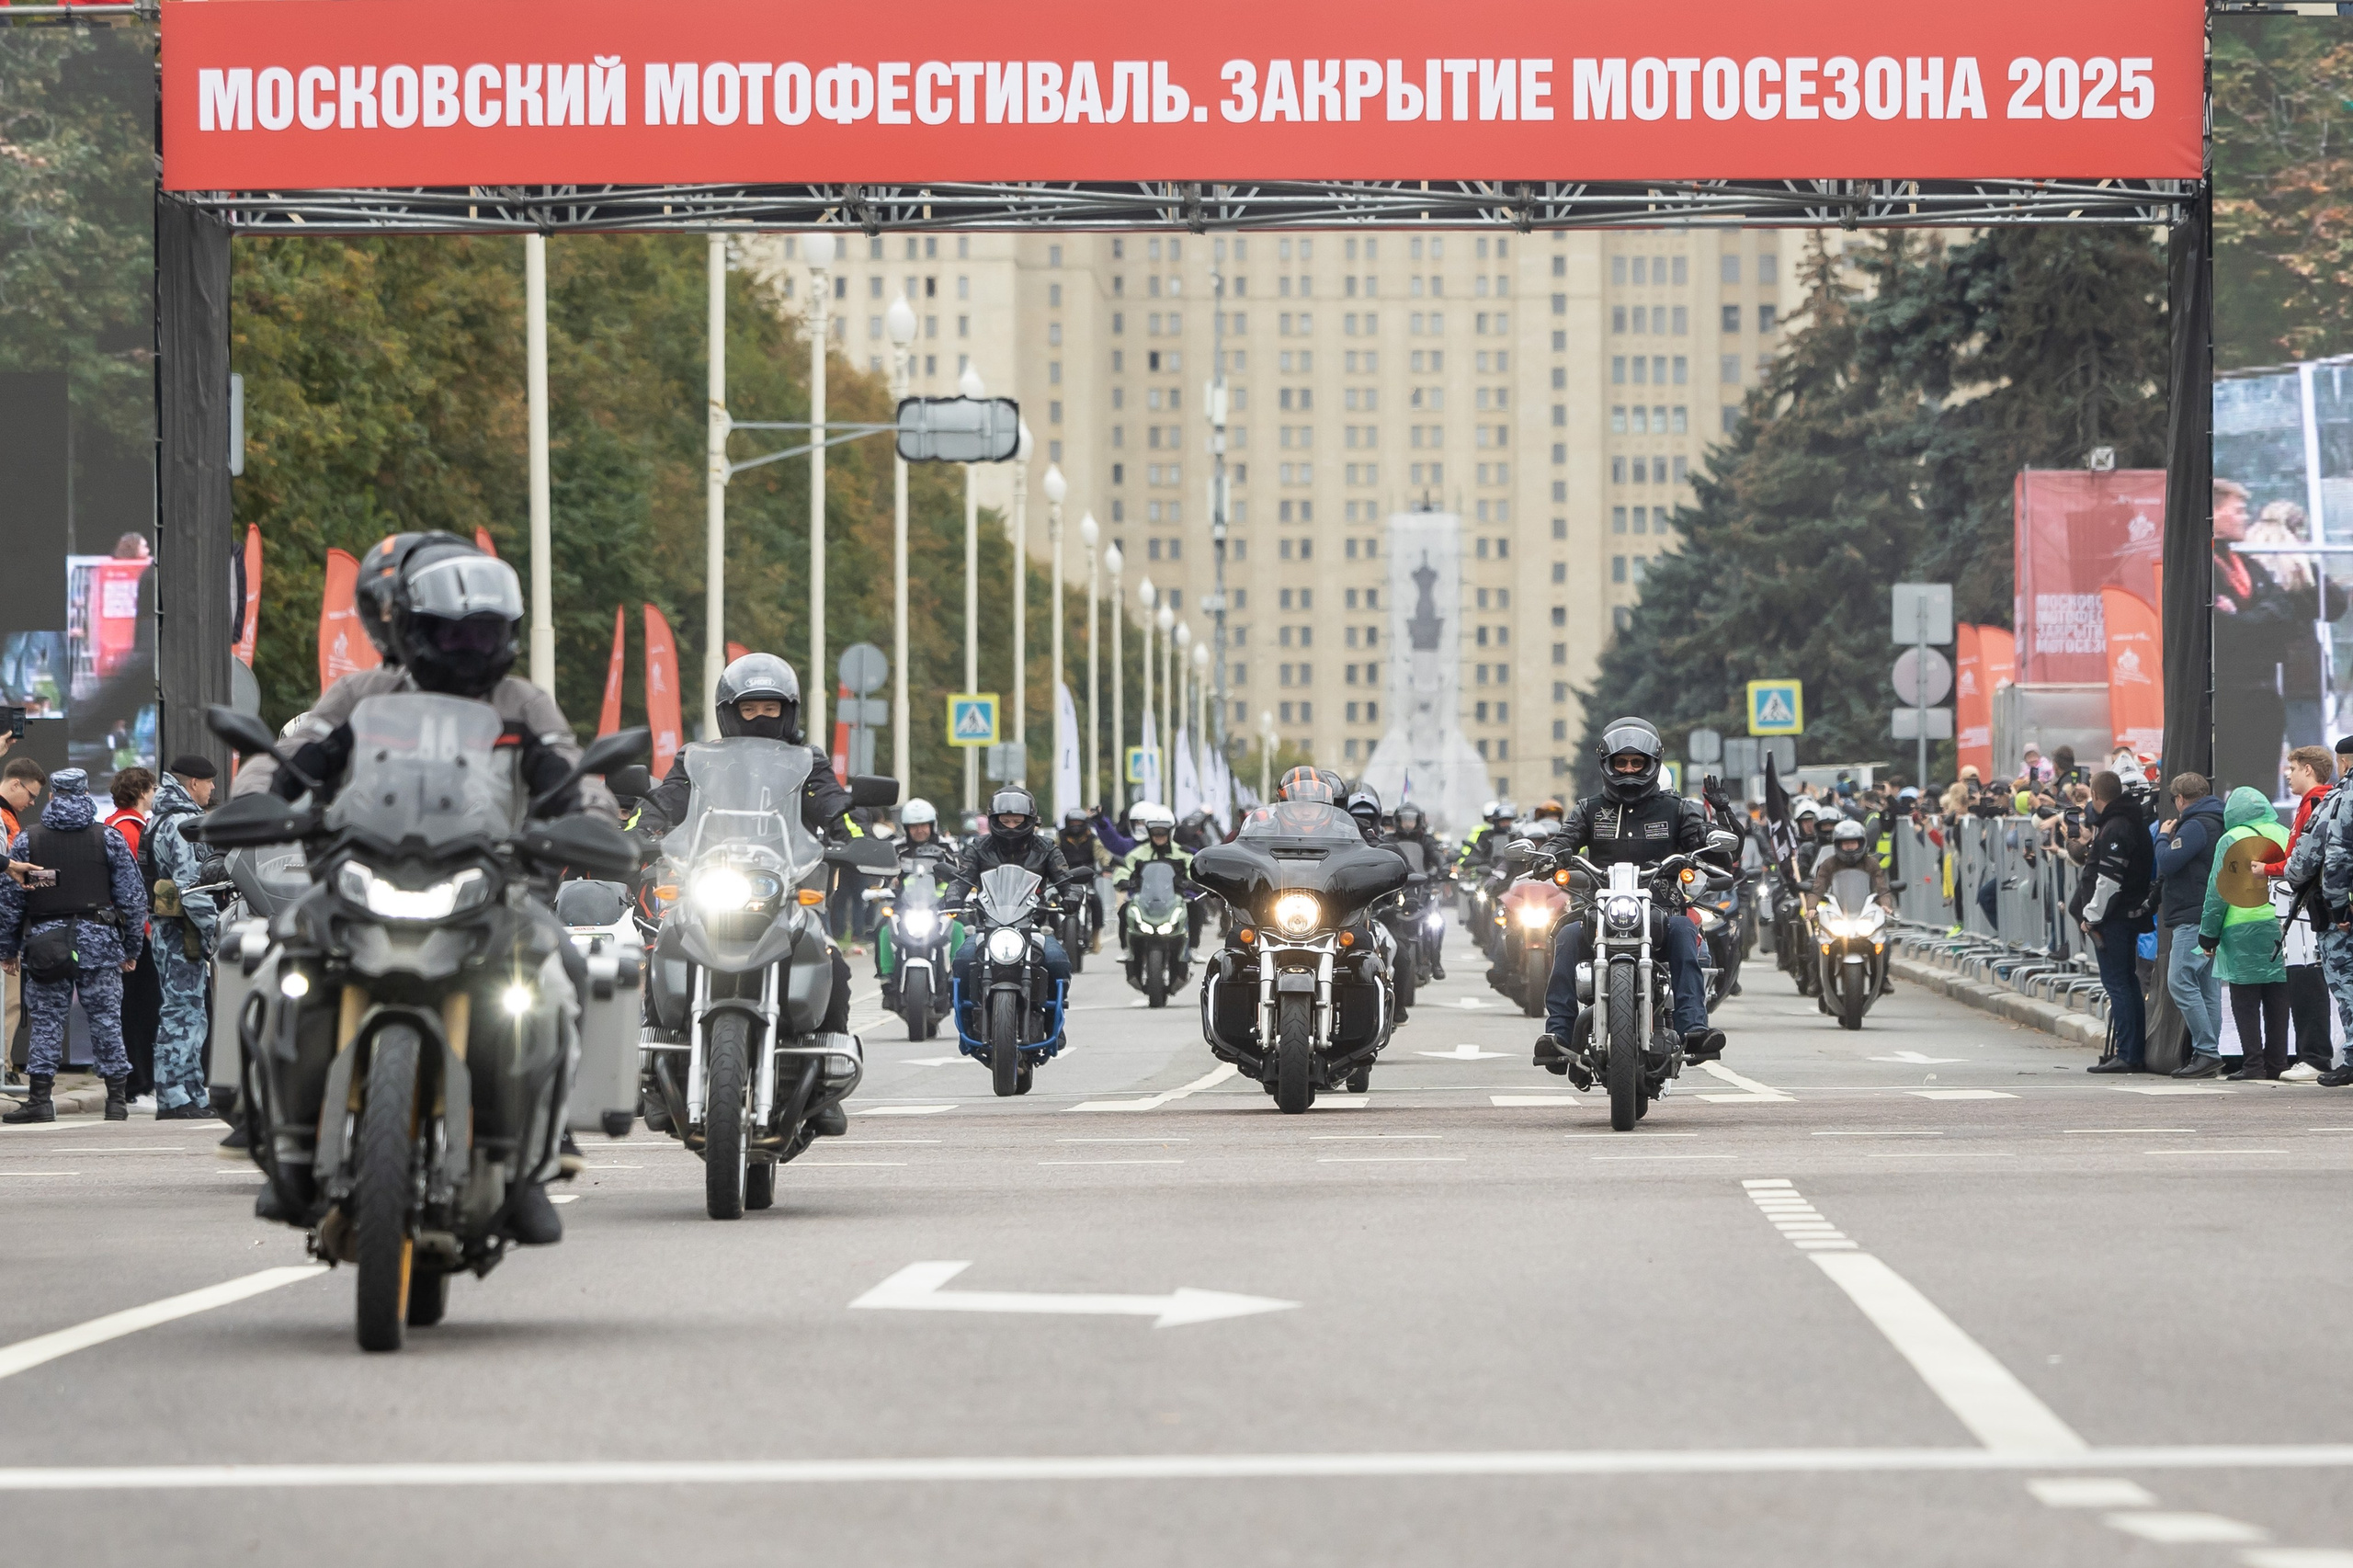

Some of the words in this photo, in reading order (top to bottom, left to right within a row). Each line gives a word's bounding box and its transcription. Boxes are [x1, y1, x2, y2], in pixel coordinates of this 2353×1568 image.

[199, 55, 626, 131] МОСКОВСКИЙ
[644, 60, 1208, 126] МОТОФЕСТИВАЛЬ.
[1220, 59, 1554, 122] ЗАКРЫТИЕ
[1573, 56, 1988, 120] МОТОСЕЗОНА
[2006, 57, 2154, 119] 2025
